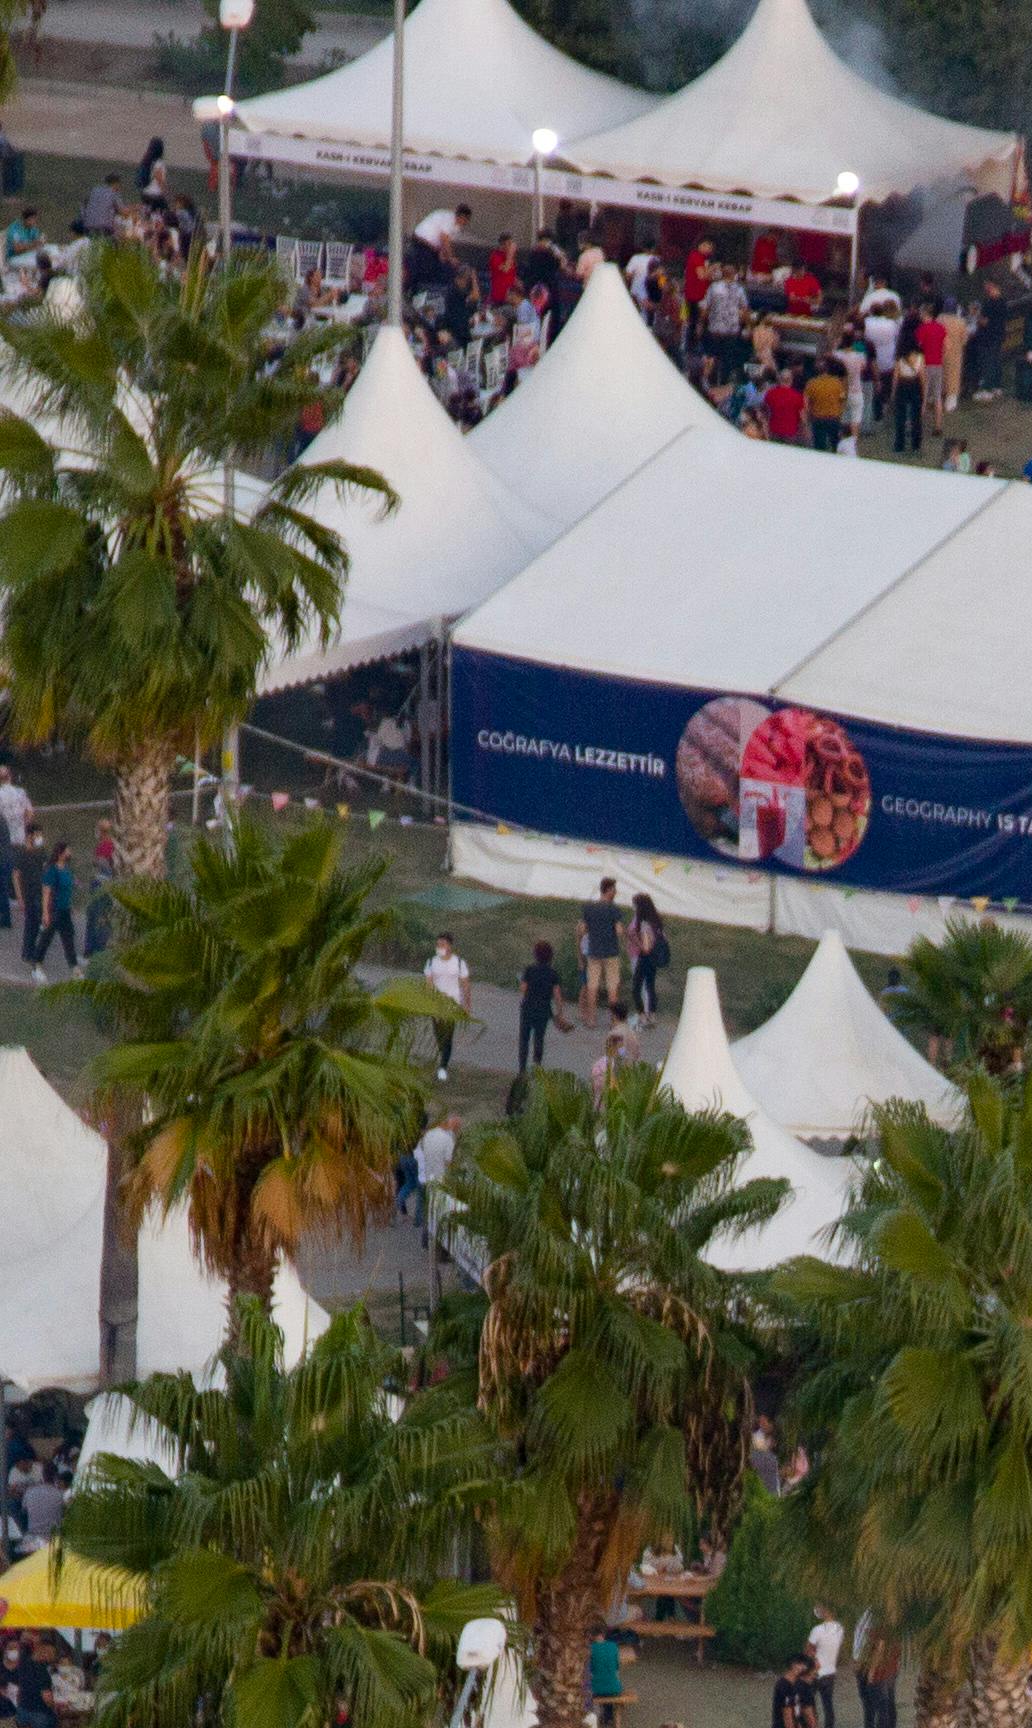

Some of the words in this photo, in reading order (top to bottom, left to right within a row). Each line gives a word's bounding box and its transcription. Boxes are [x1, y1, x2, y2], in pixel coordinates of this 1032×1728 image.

[404, 160, 433, 172] EBAP
[477, 729, 571, 760] COĞRAFYA
[575, 745, 665, 776] LEZZETTİR
[881, 794, 992, 829] GEOGRAPHY
[997, 813, 1014, 832] IS
